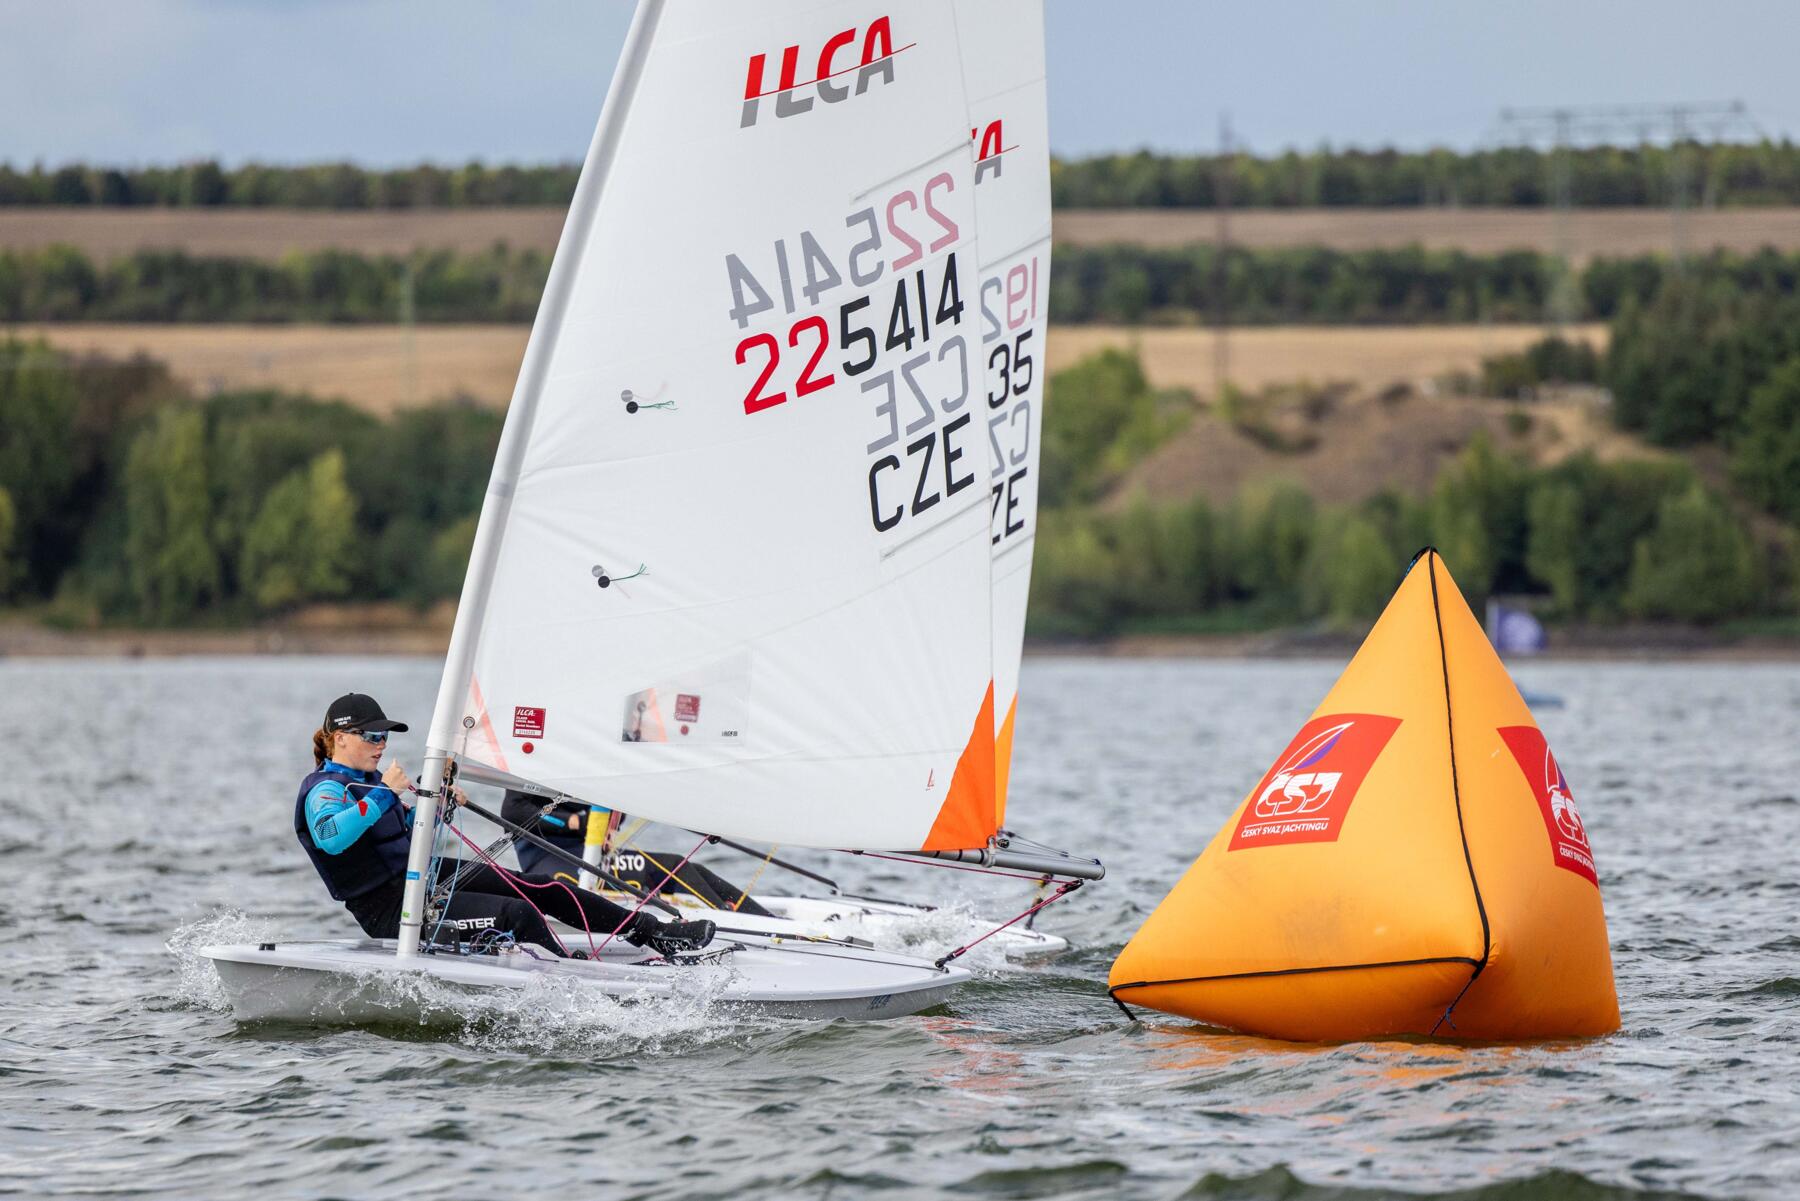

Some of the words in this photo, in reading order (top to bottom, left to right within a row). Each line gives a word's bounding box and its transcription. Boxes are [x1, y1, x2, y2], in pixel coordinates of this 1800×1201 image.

[740, 16, 895, 128] ILCA
[971, 119, 1003, 185] A
[734, 252, 965, 416] 225414
[987, 328, 1033, 409] 35
[868, 412, 975, 533] CZE
[1262, 824, 1281, 835] SVAZ
[1281, 821, 1329, 835] JACHTINGU
